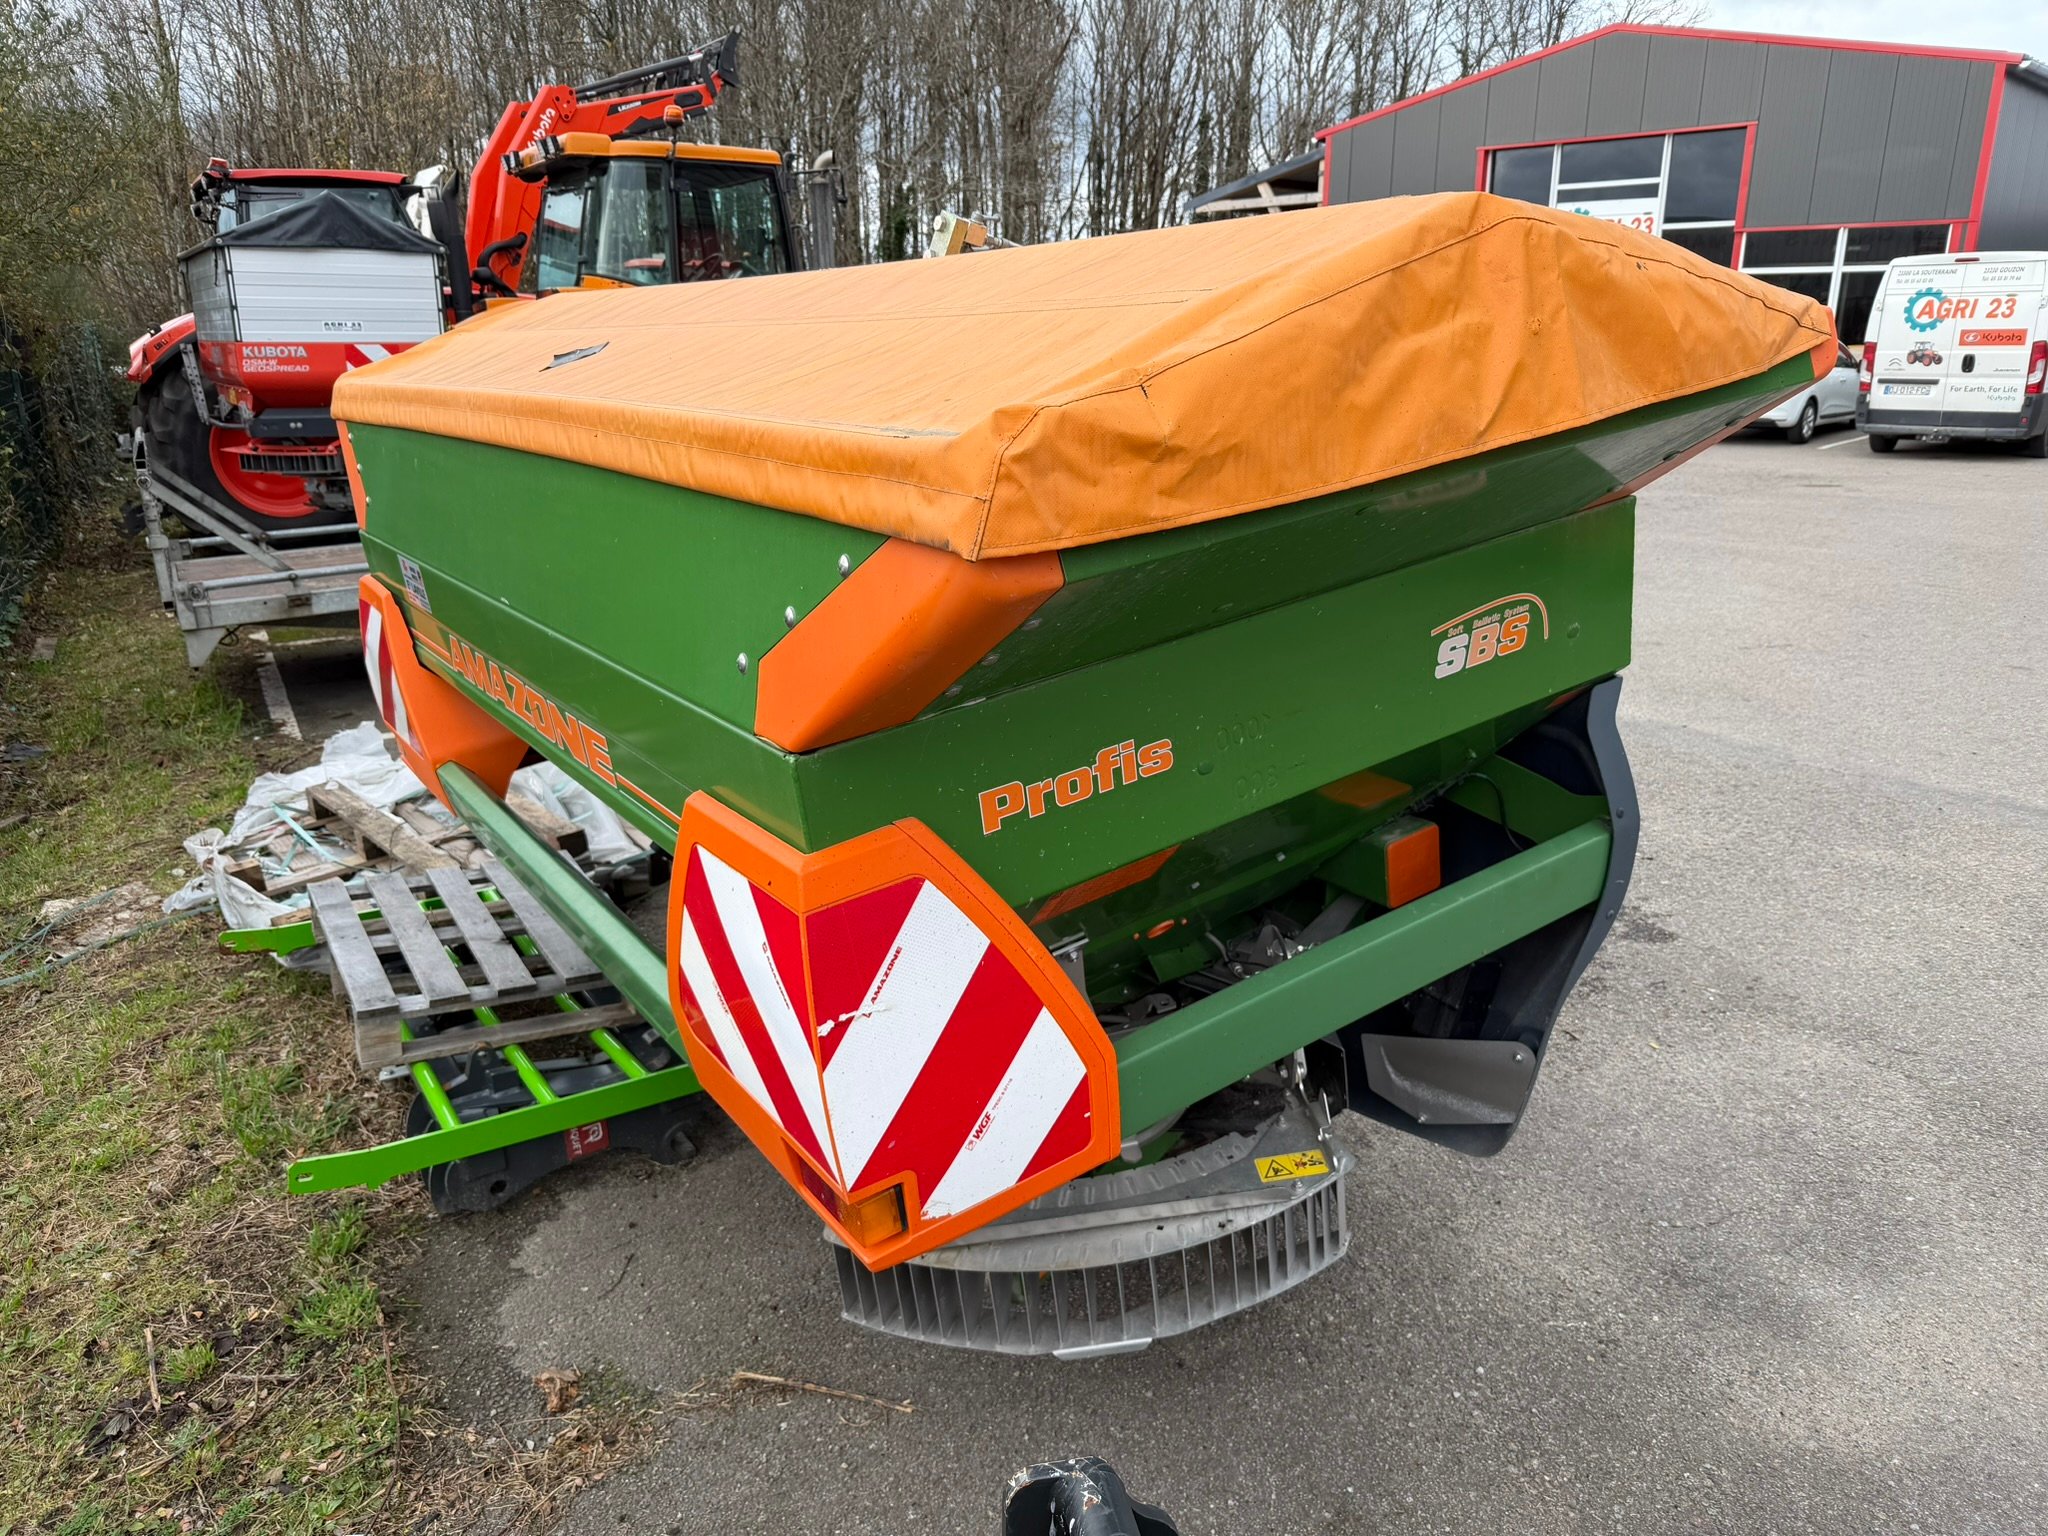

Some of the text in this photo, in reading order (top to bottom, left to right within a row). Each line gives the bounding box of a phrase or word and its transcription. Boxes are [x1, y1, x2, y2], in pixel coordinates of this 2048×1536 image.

[1920, 268, 1958, 276] SOUTERRAINE
[1916, 297, 2017, 320] AGRI 23
[242, 346, 307, 358] KUBOTA
[1982, 333, 2022, 342] Kubota
[1963, 385, 1987, 393] Earth,
[1448, 624, 1464, 638] Soft
[1503, 604, 1530, 618] System
[1434, 612, 1530, 680] SBS
[449, 634, 617, 789] AMAZONE
[978, 738, 1174, 836] Profis
[871, 946, 902, 1005] AMAZONE
[972, 1111, 991, 1140] WGF
